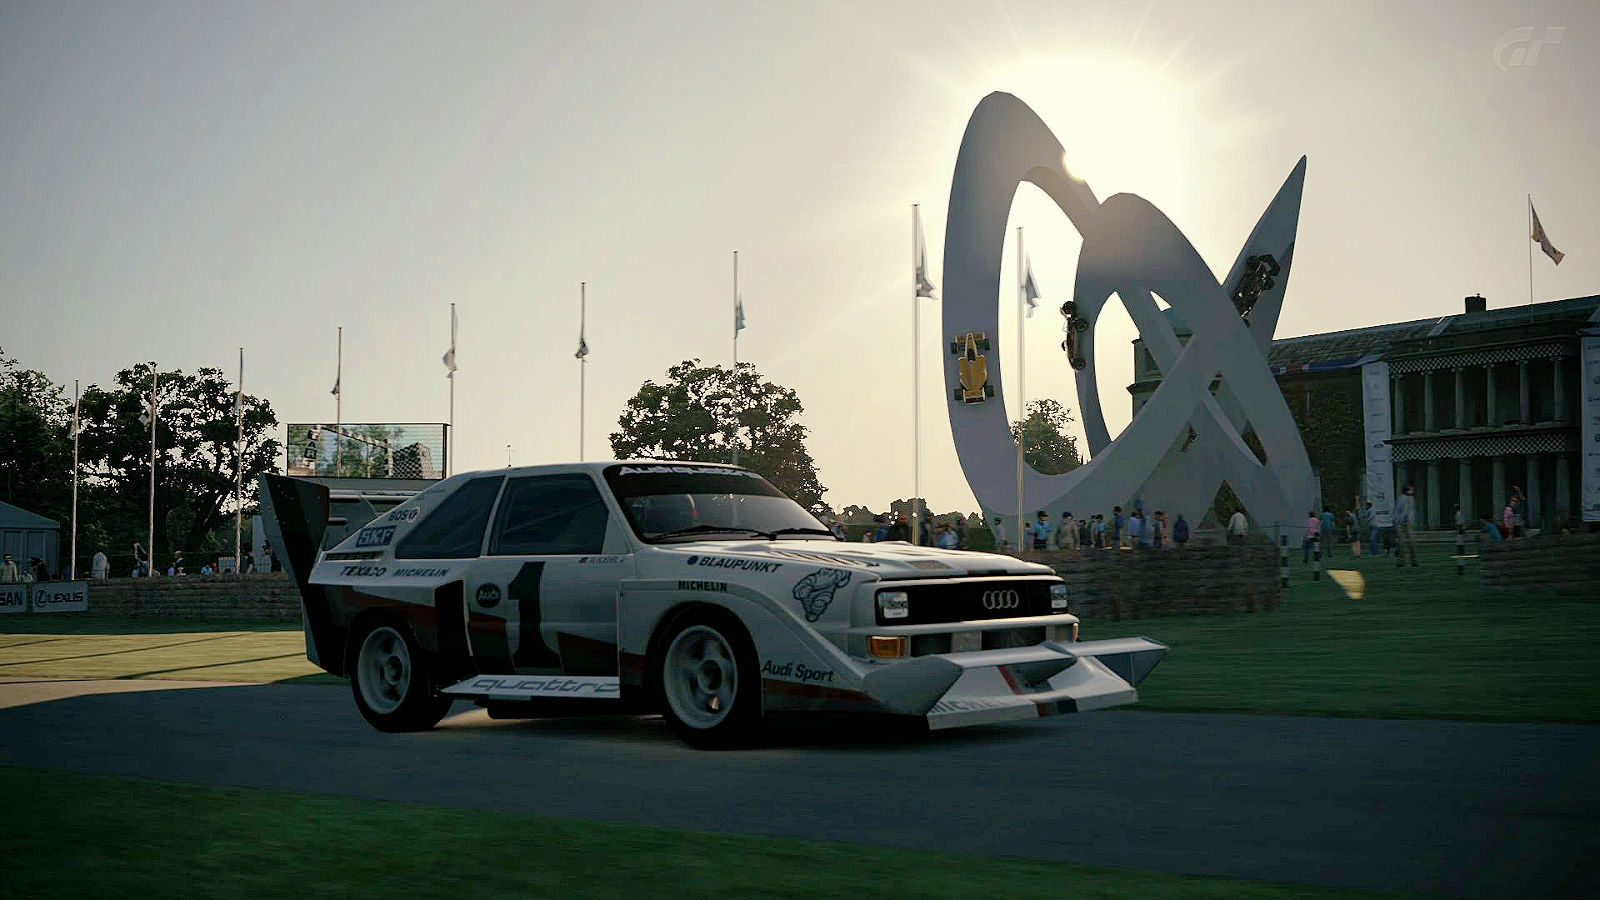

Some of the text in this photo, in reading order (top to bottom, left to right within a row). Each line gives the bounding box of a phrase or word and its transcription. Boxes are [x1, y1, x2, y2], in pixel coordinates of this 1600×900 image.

[359, 528, 394, 546] SKF
[340, 566, 387, 577] TEXACO
[699, 557, 783, 573] BLAUPUNKT
[393, 568, 449, 577] MICHELIN
[678, 581, 728, 592] MICHELIN
[47, 592, 84, 603] LEXUS
[507, 561, 562, 668] 1
[762, 660, 834, 682] Audi Sport
[471, 679, 620, 692] quattro
